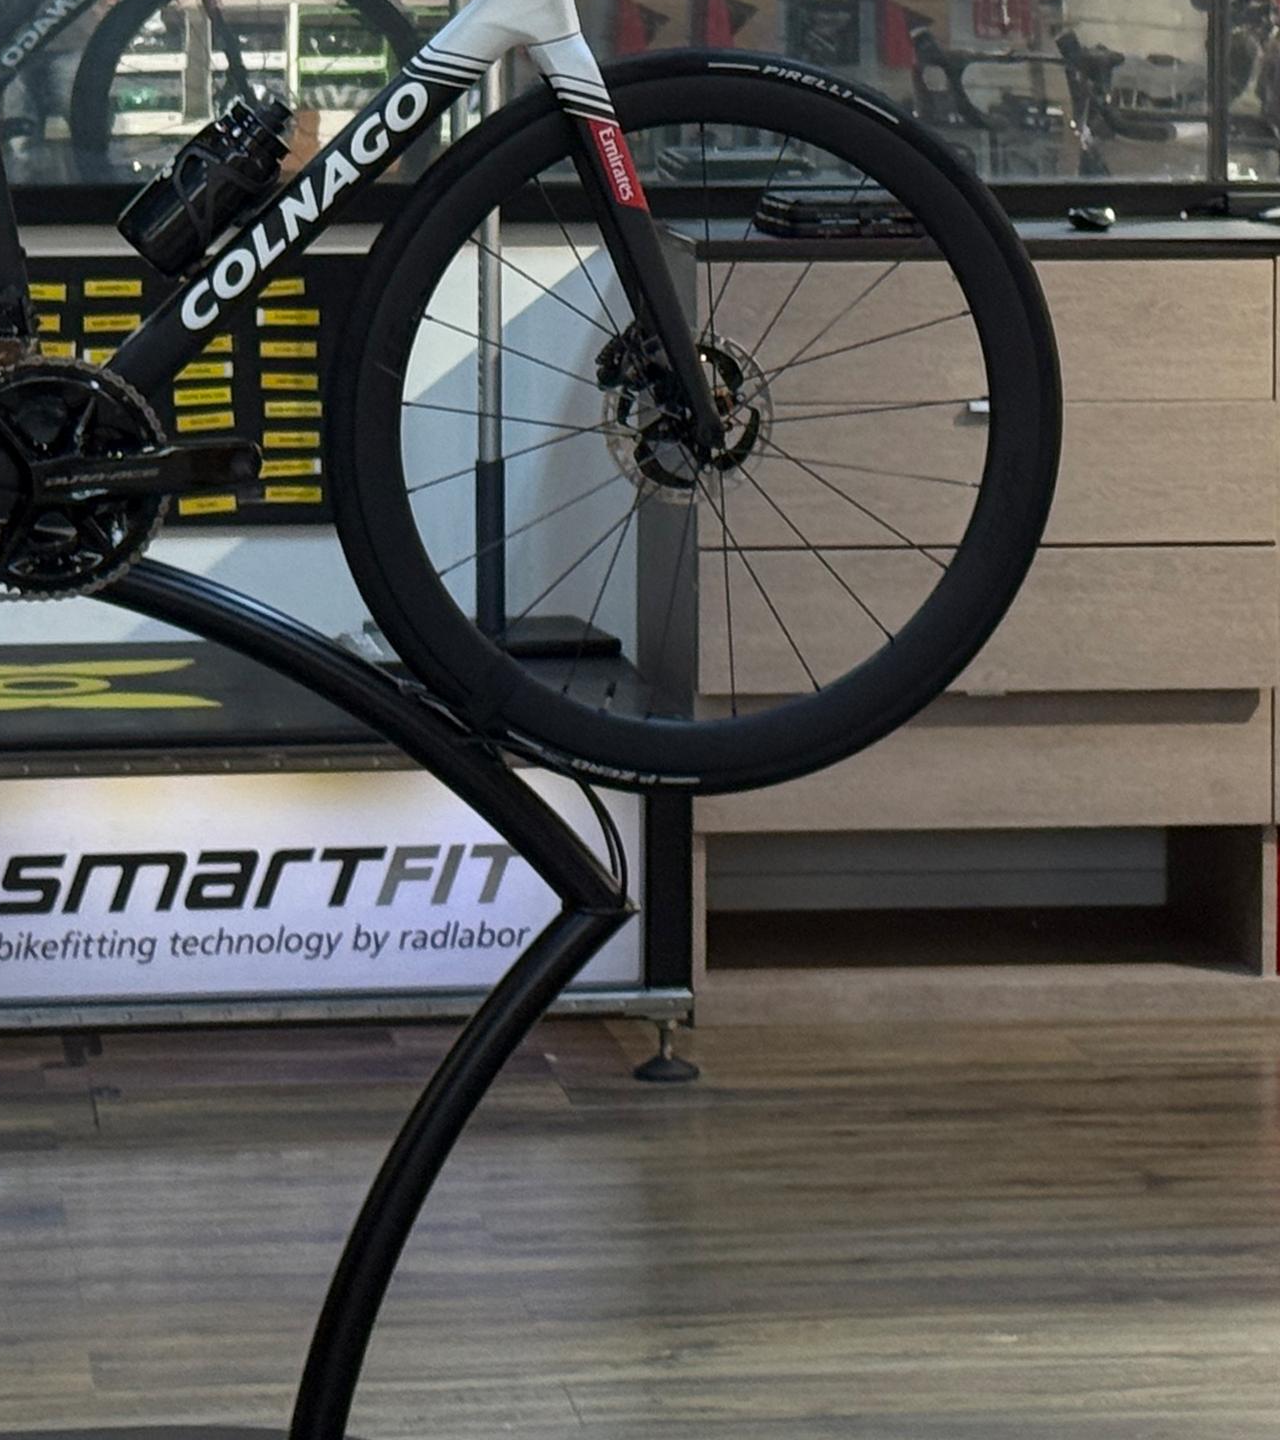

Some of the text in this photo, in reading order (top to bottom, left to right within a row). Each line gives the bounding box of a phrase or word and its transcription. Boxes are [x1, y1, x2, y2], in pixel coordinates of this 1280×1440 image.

[761, 63, 853, 101] PIRELLI
[597, 125, 635, 201] Emirates
[180, 82, 429, 332] COLNAGO
[170, 923, 343, 960] technology
[353, 921, 390, 955] by
[399, 919, 531, 953] radlabor
